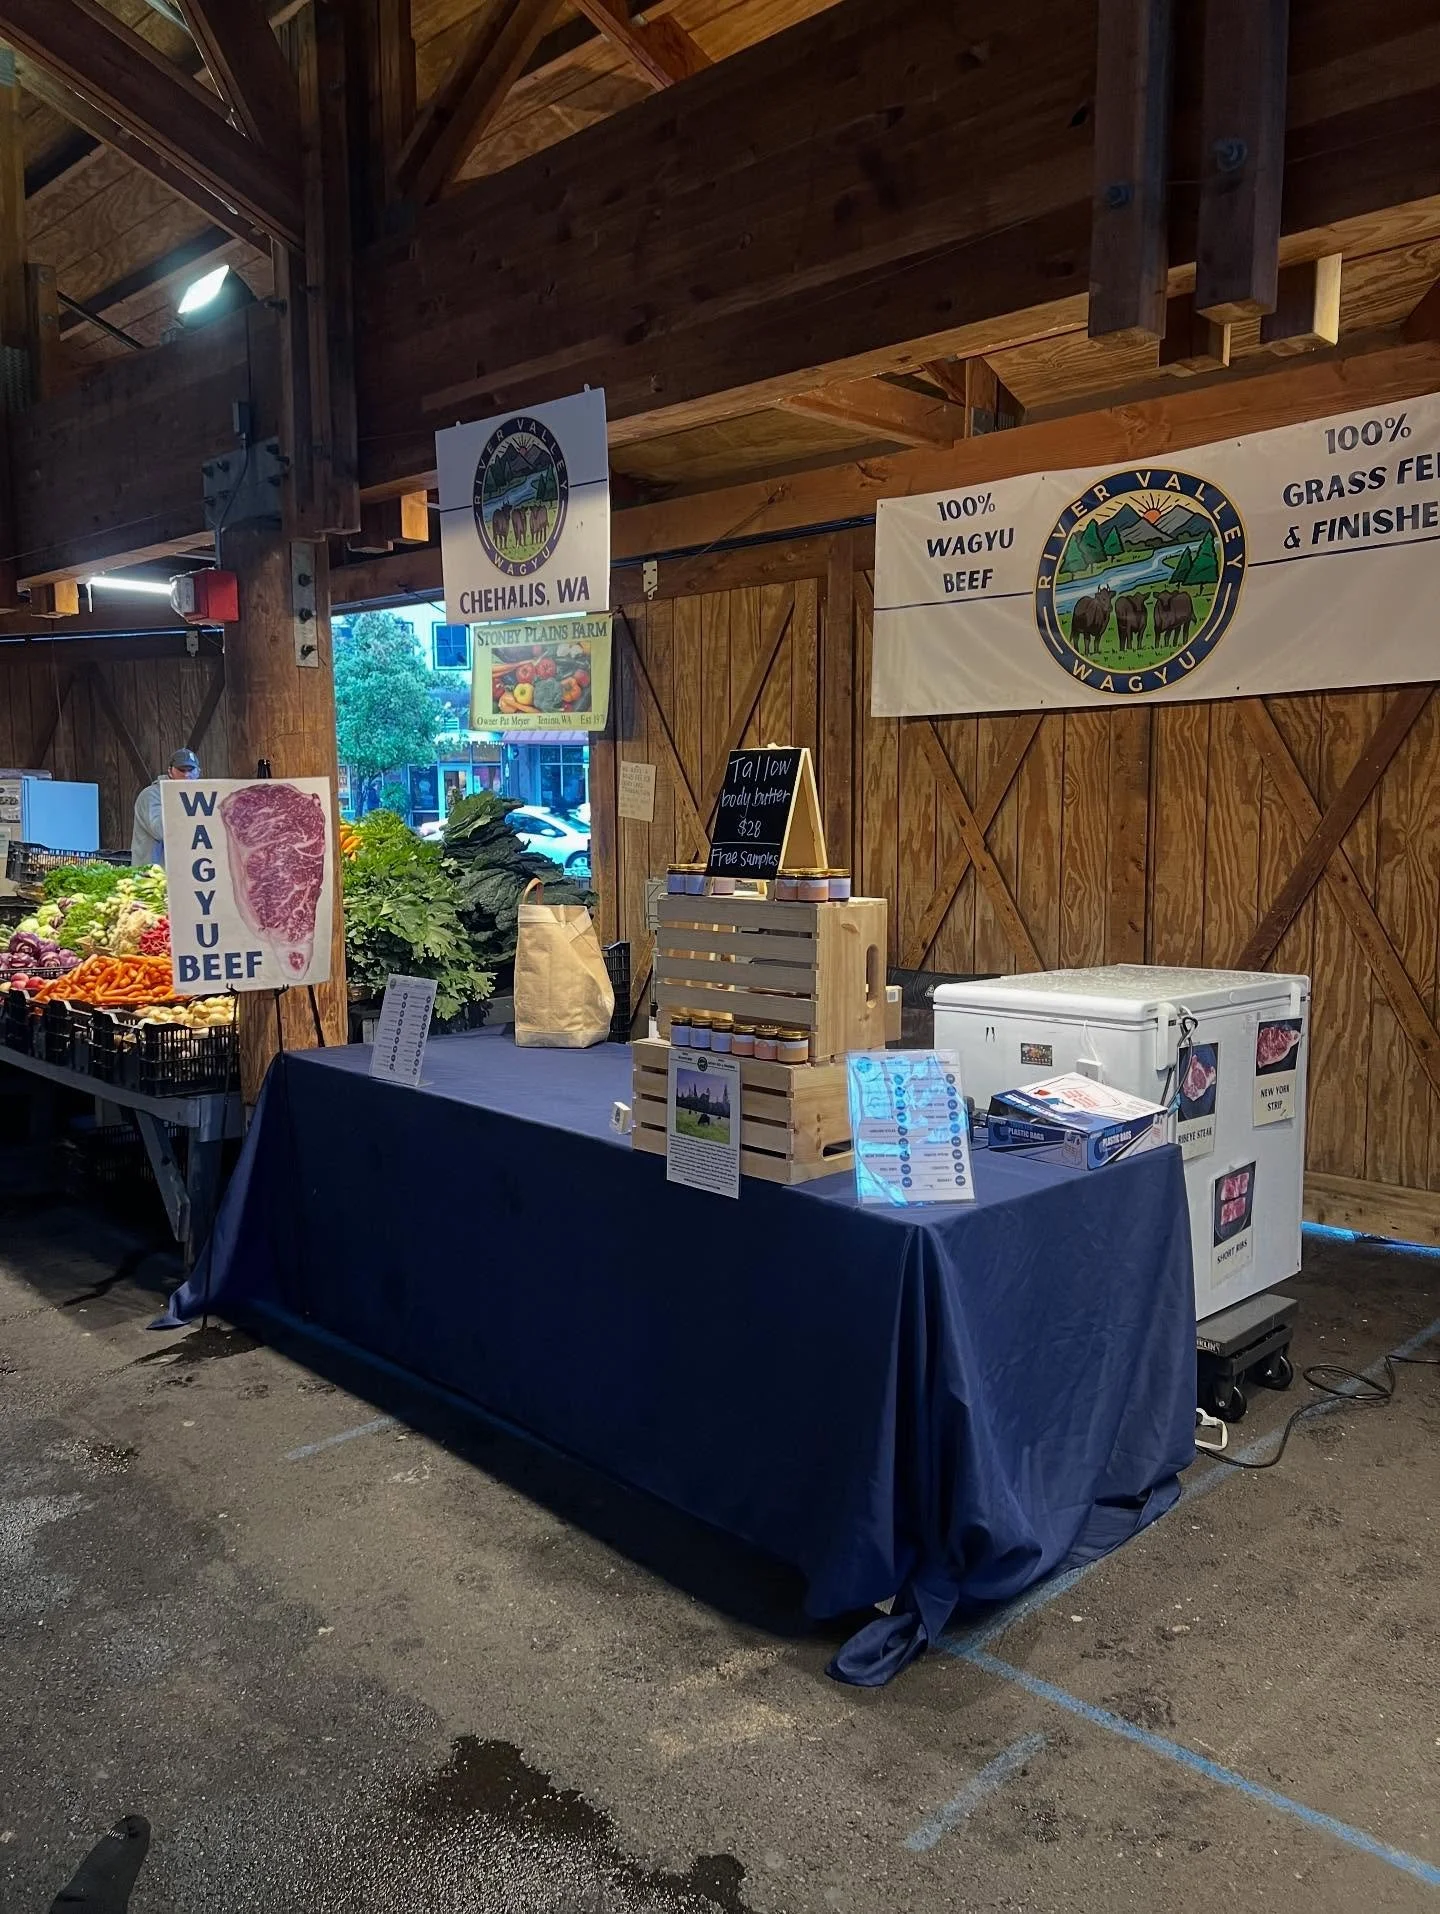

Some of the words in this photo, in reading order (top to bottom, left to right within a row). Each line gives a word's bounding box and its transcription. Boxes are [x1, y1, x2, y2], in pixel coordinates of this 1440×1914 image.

[1324, 413, 1412, 454] 100%
[474, 431, 504, 505] RIVER
[517, 417, 568, 490] VALLEY
[1282, 466, 1388, 507] GRASS
[1396, 452, 1440, 485] FE
[937, 492, 996, 522] 100%
[926, 527, 1015, 558] WAGYU
[1037, 485, 1110, 590] RIVER
[1135, 472, 1243, 569] VALLEY
[1283, 525, 1301, 549] &
[492, 549, 551, 576] WAGYU
[459, 582, 550, 614] CHEHALIS,
[557, 576, 590, 603] WA
[942, 568, 994, 594] BEEF
[525, 625, 569, 642] PLAINS
[572, 621, 608, 639] FARM
[1072, 650, 1196, 693] WAGYU
[729, 756, 792, 783] Tallow
[721, 786, 752, 818] body
[752, 787, 791, 807] butter
[737, 818, 762, 838] $28
[179, 791, 219, 948] WAGYU
[710, 848, 738, 867] Free
[178, 951, 263, 982] BEEF
[1260, 1087, 1275, 1098] NEW
[1276, 1084, 1290, 1095] YORK
[1267, 1100, 1283, 1111] STRIP
[1217, 1246, 1235, 1264] SHORT
